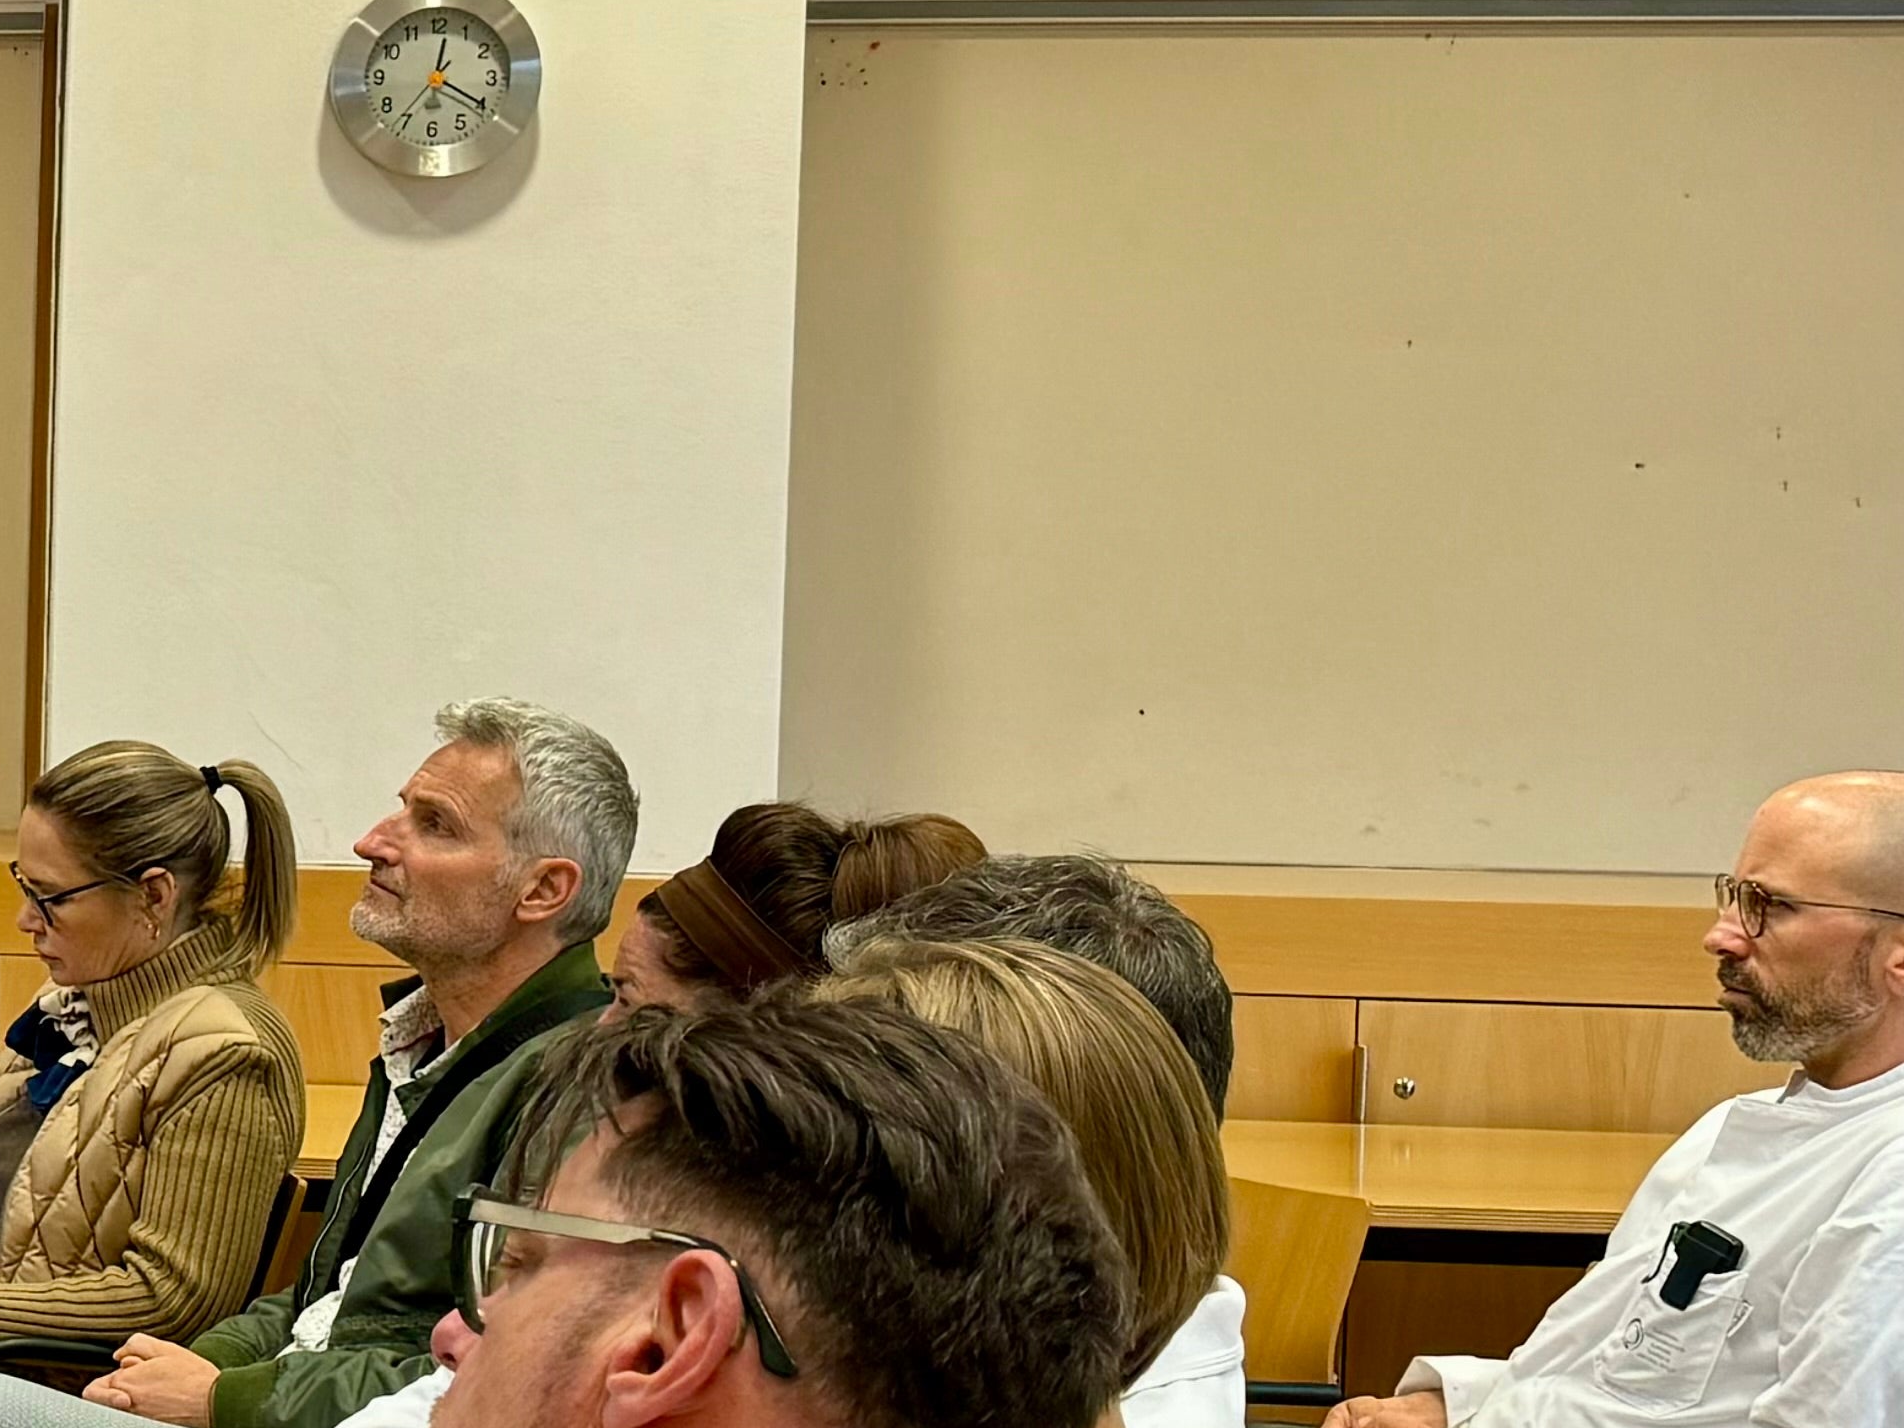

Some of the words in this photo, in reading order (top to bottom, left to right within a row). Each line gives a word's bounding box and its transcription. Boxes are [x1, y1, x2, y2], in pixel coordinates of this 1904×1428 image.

[404, 25, 418, 41] 11
[431, 17, 448, 34] 12
[462, 25, 468, 41] 1
[383, 43, 400, 60] 10
[477, 43, 490, 59] 2
[373, 69, 385, 85] 9
[485, 69, 497, 86] 3
[381, 96, 392, 113] 8
[400, 113, 413, 130] 7
[426, 121, 438, 137] 6
[454, 113, 466, 130] 5
